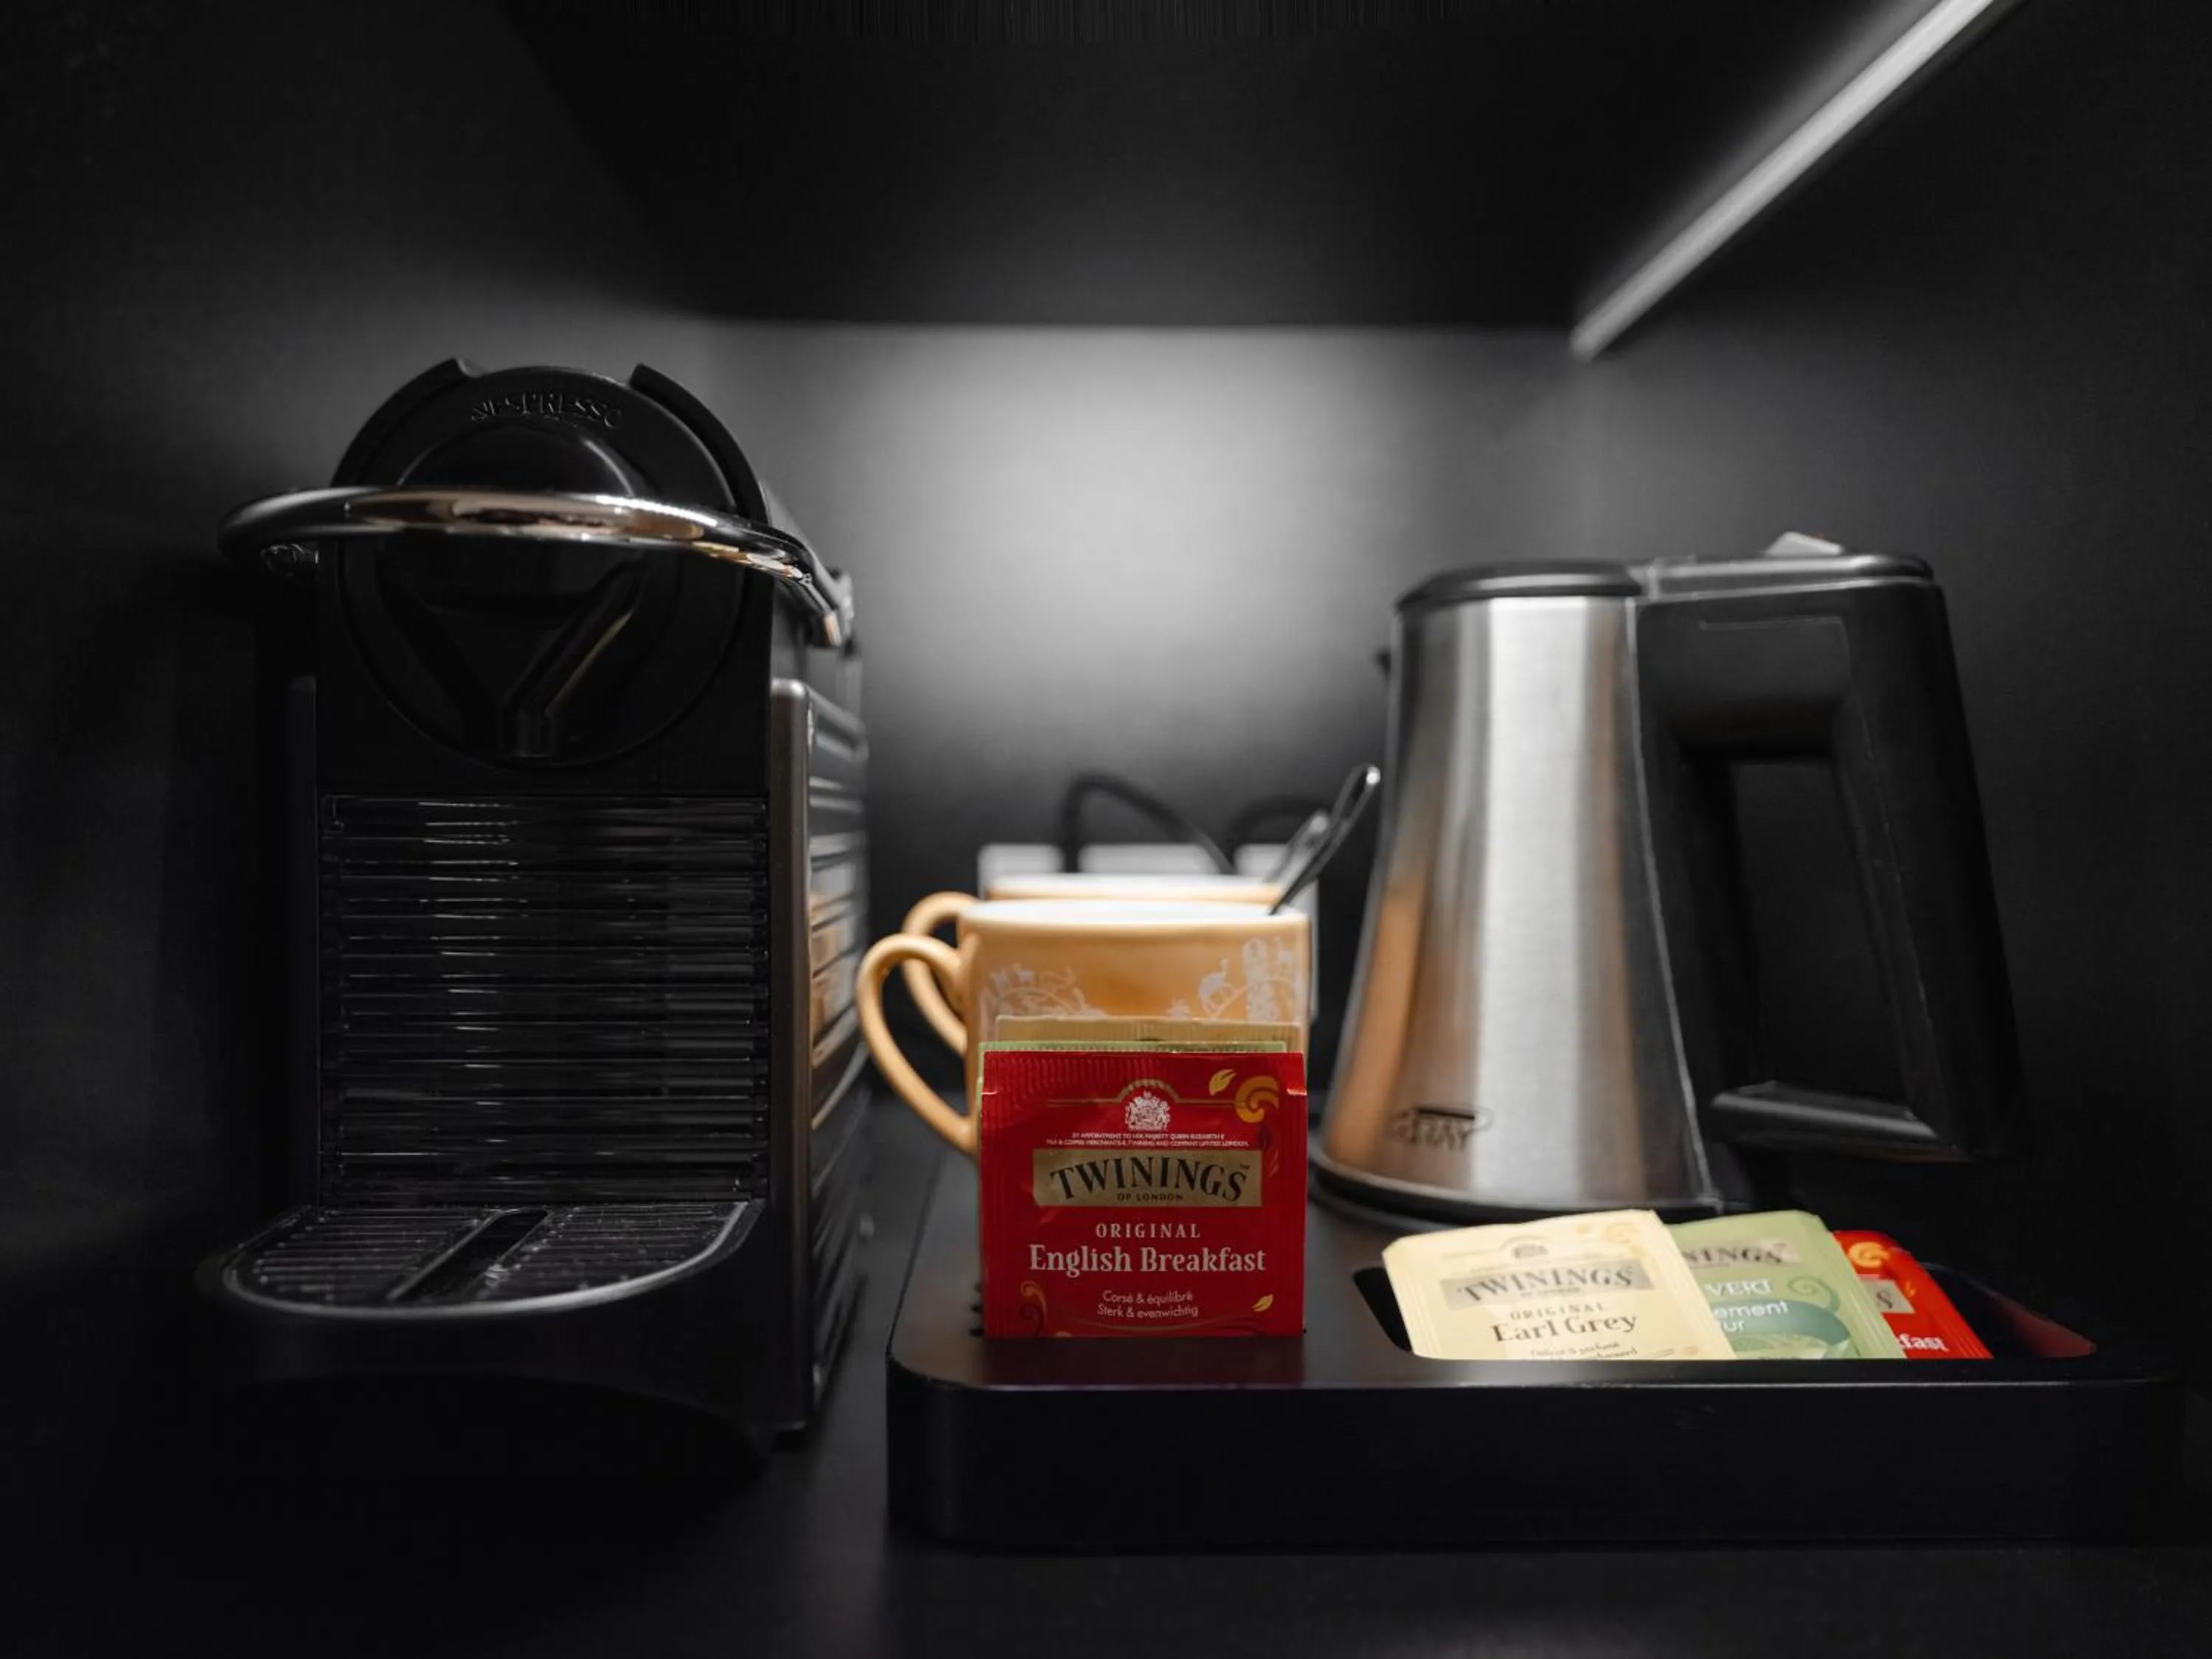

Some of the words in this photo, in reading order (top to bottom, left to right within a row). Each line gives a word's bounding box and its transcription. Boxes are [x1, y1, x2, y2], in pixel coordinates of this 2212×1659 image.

[1049, 1155, 1248, 1202] TWININGS
[1117, 1192, 1132, 1201] OF
[1136, 1192, 1183, 1201] LONDON
[1095, 1222, 1201, 1238] ORIGINAL
[1029, 1244, 1133, 1278] English
[1139, 1247, 1267, 1272] Breakfast
[1456, 1266, 1632, 1301] TWININGS
[1136, 1293, 1145, 1304] &
[1097, 1303, 1124, 1318] Sterk
[1126, 1306, 1135, 1318] &
[1510, 1301, 1607, 1320] ORIGINAL
[1490, 1319, 1560, 1342] Earl
[1565, 1315, 1638, 1335] Grey
[1717, 1320, 1746, 1333] ur
